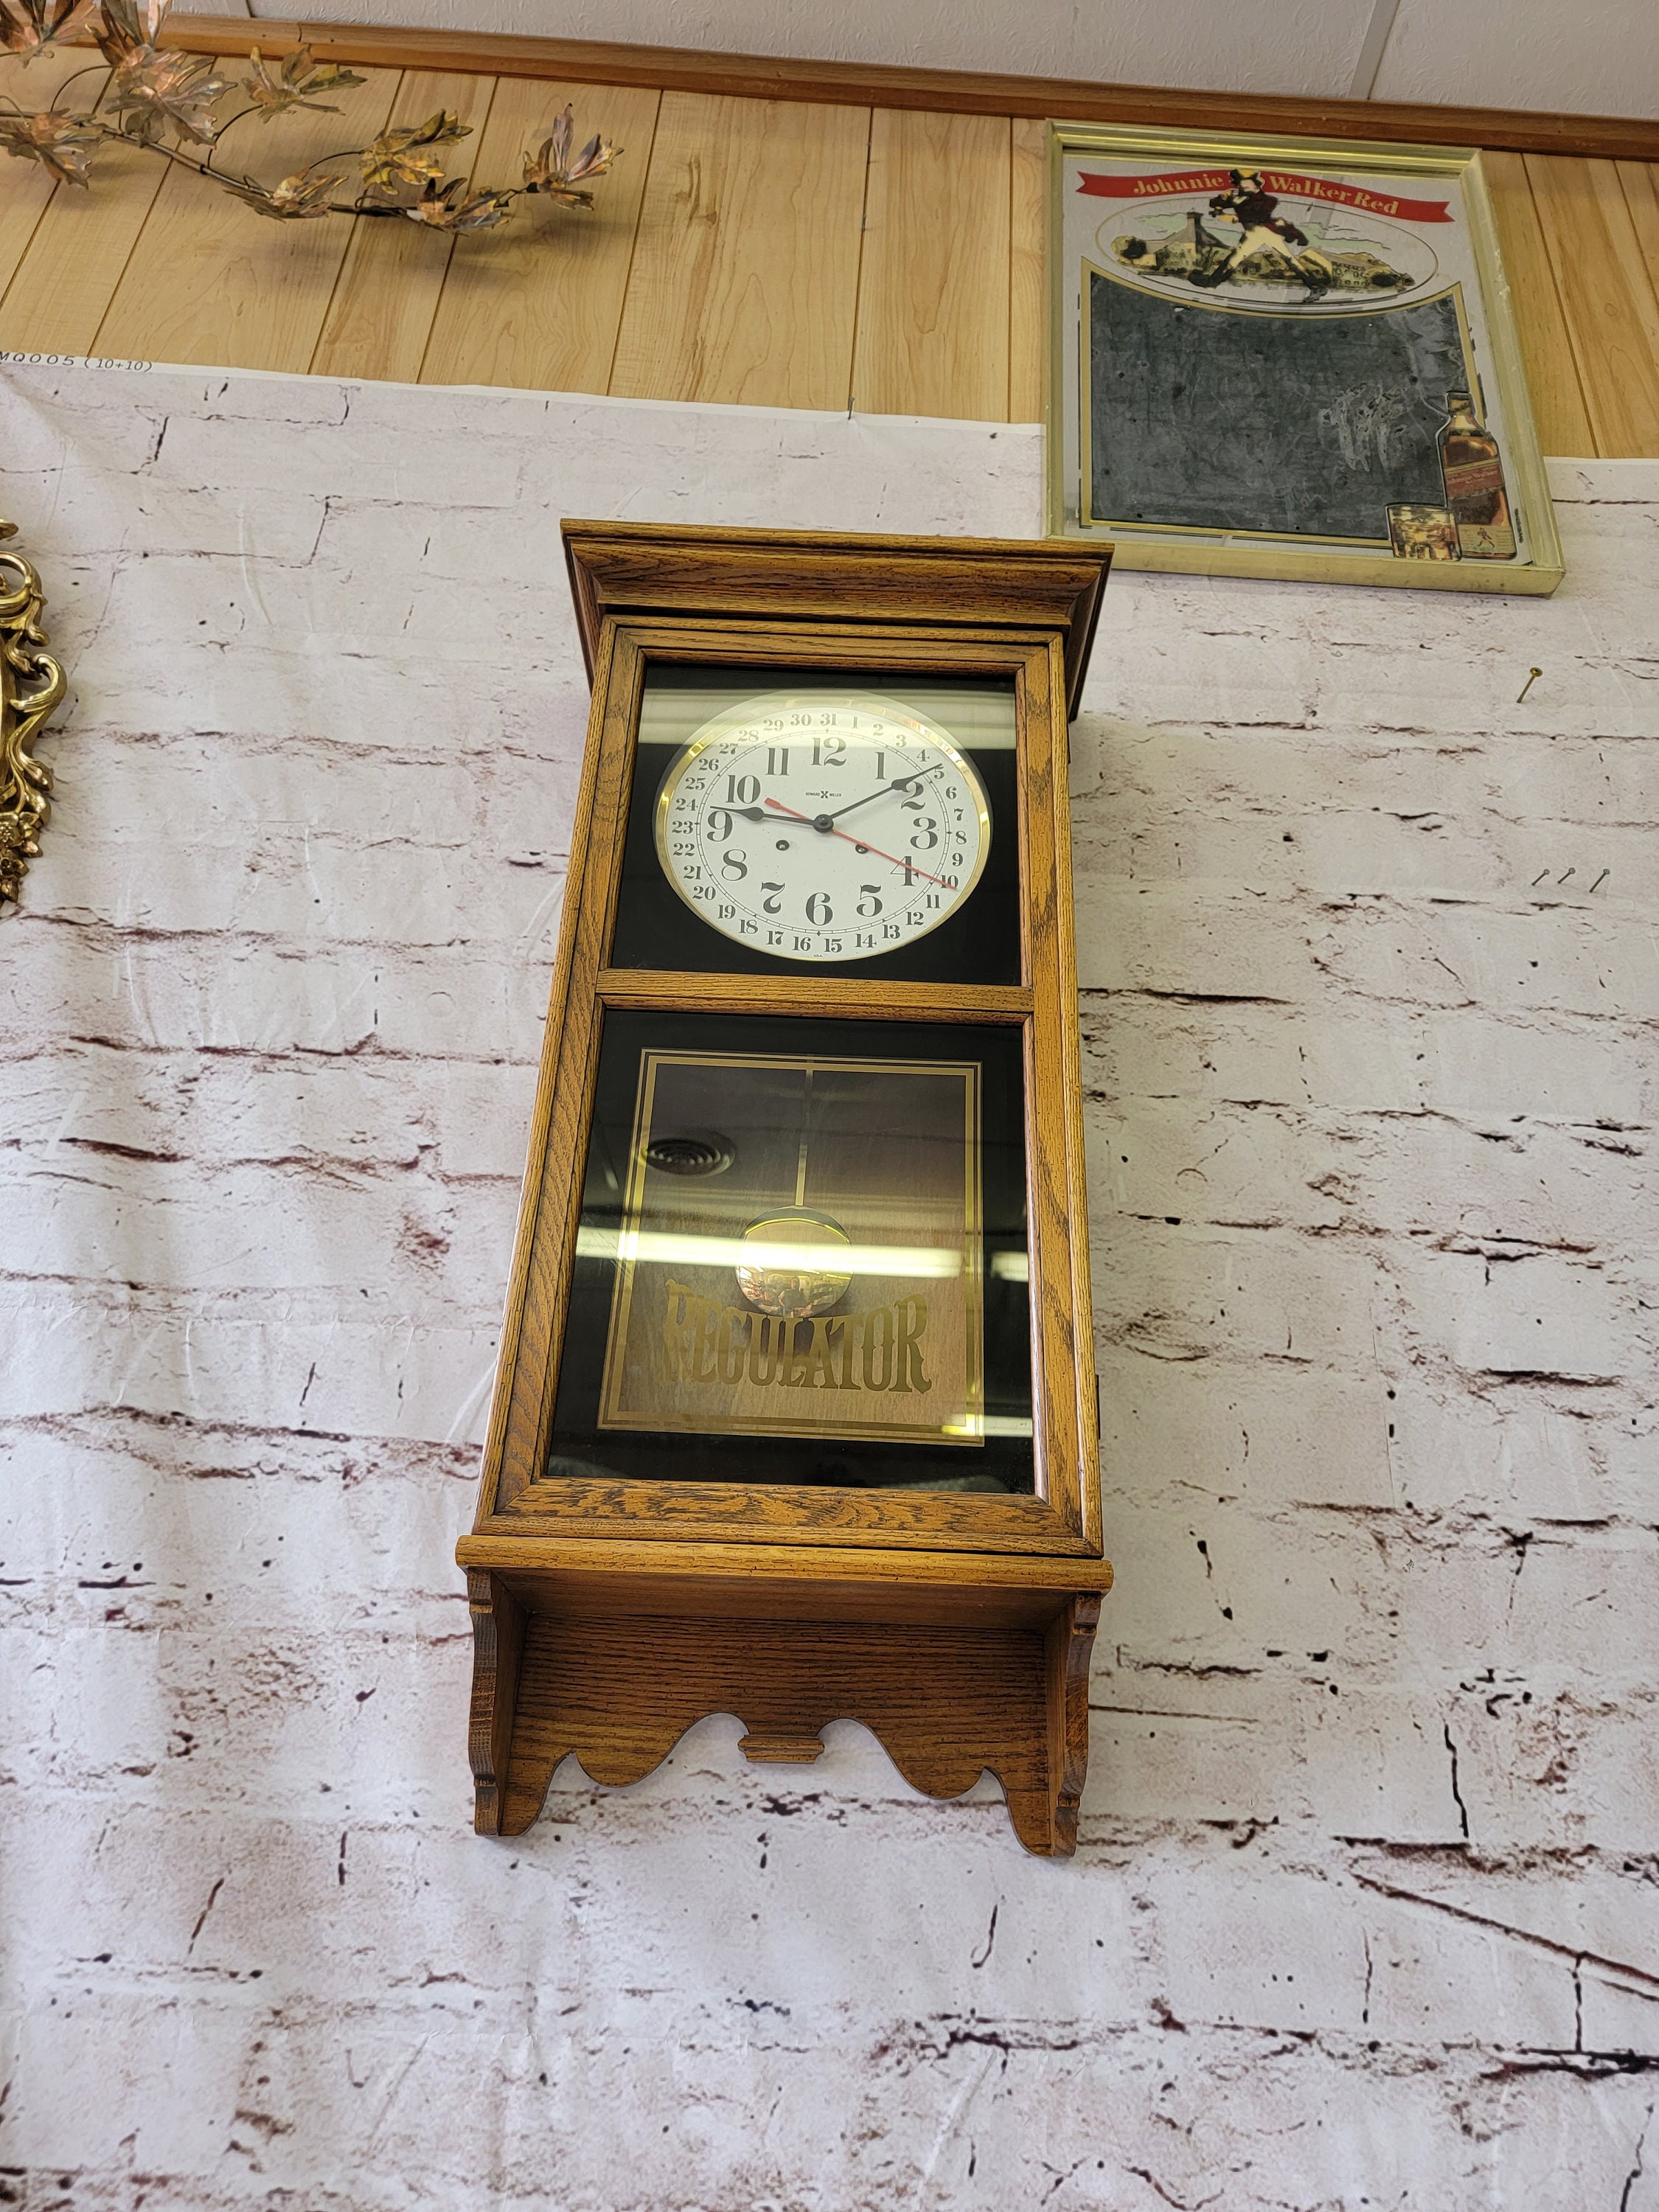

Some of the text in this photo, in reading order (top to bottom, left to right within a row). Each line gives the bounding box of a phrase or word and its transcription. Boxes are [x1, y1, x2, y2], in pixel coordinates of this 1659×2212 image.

[1133, 174, 1400, 215] Johnnie Walker Red
[84, 357, 153, 373] (10+10)
[763, 720, 784, 731] 29
[790, 714, 811, 726] 30
[820, 713, 837, 726] 31
[853, 716, 860, 729] 1
[738, 730, 759, 742] 28
[873, 724, 884, 736] 2
[719, 742, 739, 754] 27
[896, 735, 908, 747] 3
[811, 737, 846, 766] 12
[917, 749, 930, 762] 4
[698, 758, 720, 771] 26
[765, 748, 790, 776] 11
[874, 752, 887, 780] 1
[933, 765, 945, 779] 5
[685, 777, 706, 790] 25
[725, 774, 761, 804] 10
[901, 781, 926, 810] 2
[945, 787, 957, 799] 6
[675, 798, 698, 812] 24
[954, 808, 964, 821] 7
[672, 821, 693, 834] 23
[706, 810, 733, 842] 9
[910, 817, 939, 849] 3
[956, 830, 967, 844] 8
[673, 843, 695, 857] 22
[721, 849, 748, 881] 8
[952, 852, 964, 866] 9
[684, 866, 702, 880] 21
[890, 856, 919, 886] 4
[940, 874, 959, 888] 10
[692, 886, 716, 900] 20
[856, 884, 883, 917] 5
[925, 894, 941, 909] 11
[717, 904, 736, 919] 19
[805, 892, 833, 926] 6
[905, 911, 925, 925] 12
[739, 919, 759, 934] 18
[882, 924, 900, 939] 13
[766, 931, 784, 945] 17
[792, 936, 811, 951] 16
[855, 933, 877, 948] 14
[824, 938, 843, 953] 15
[664, 1279, 932, 1394] REGULATOR
